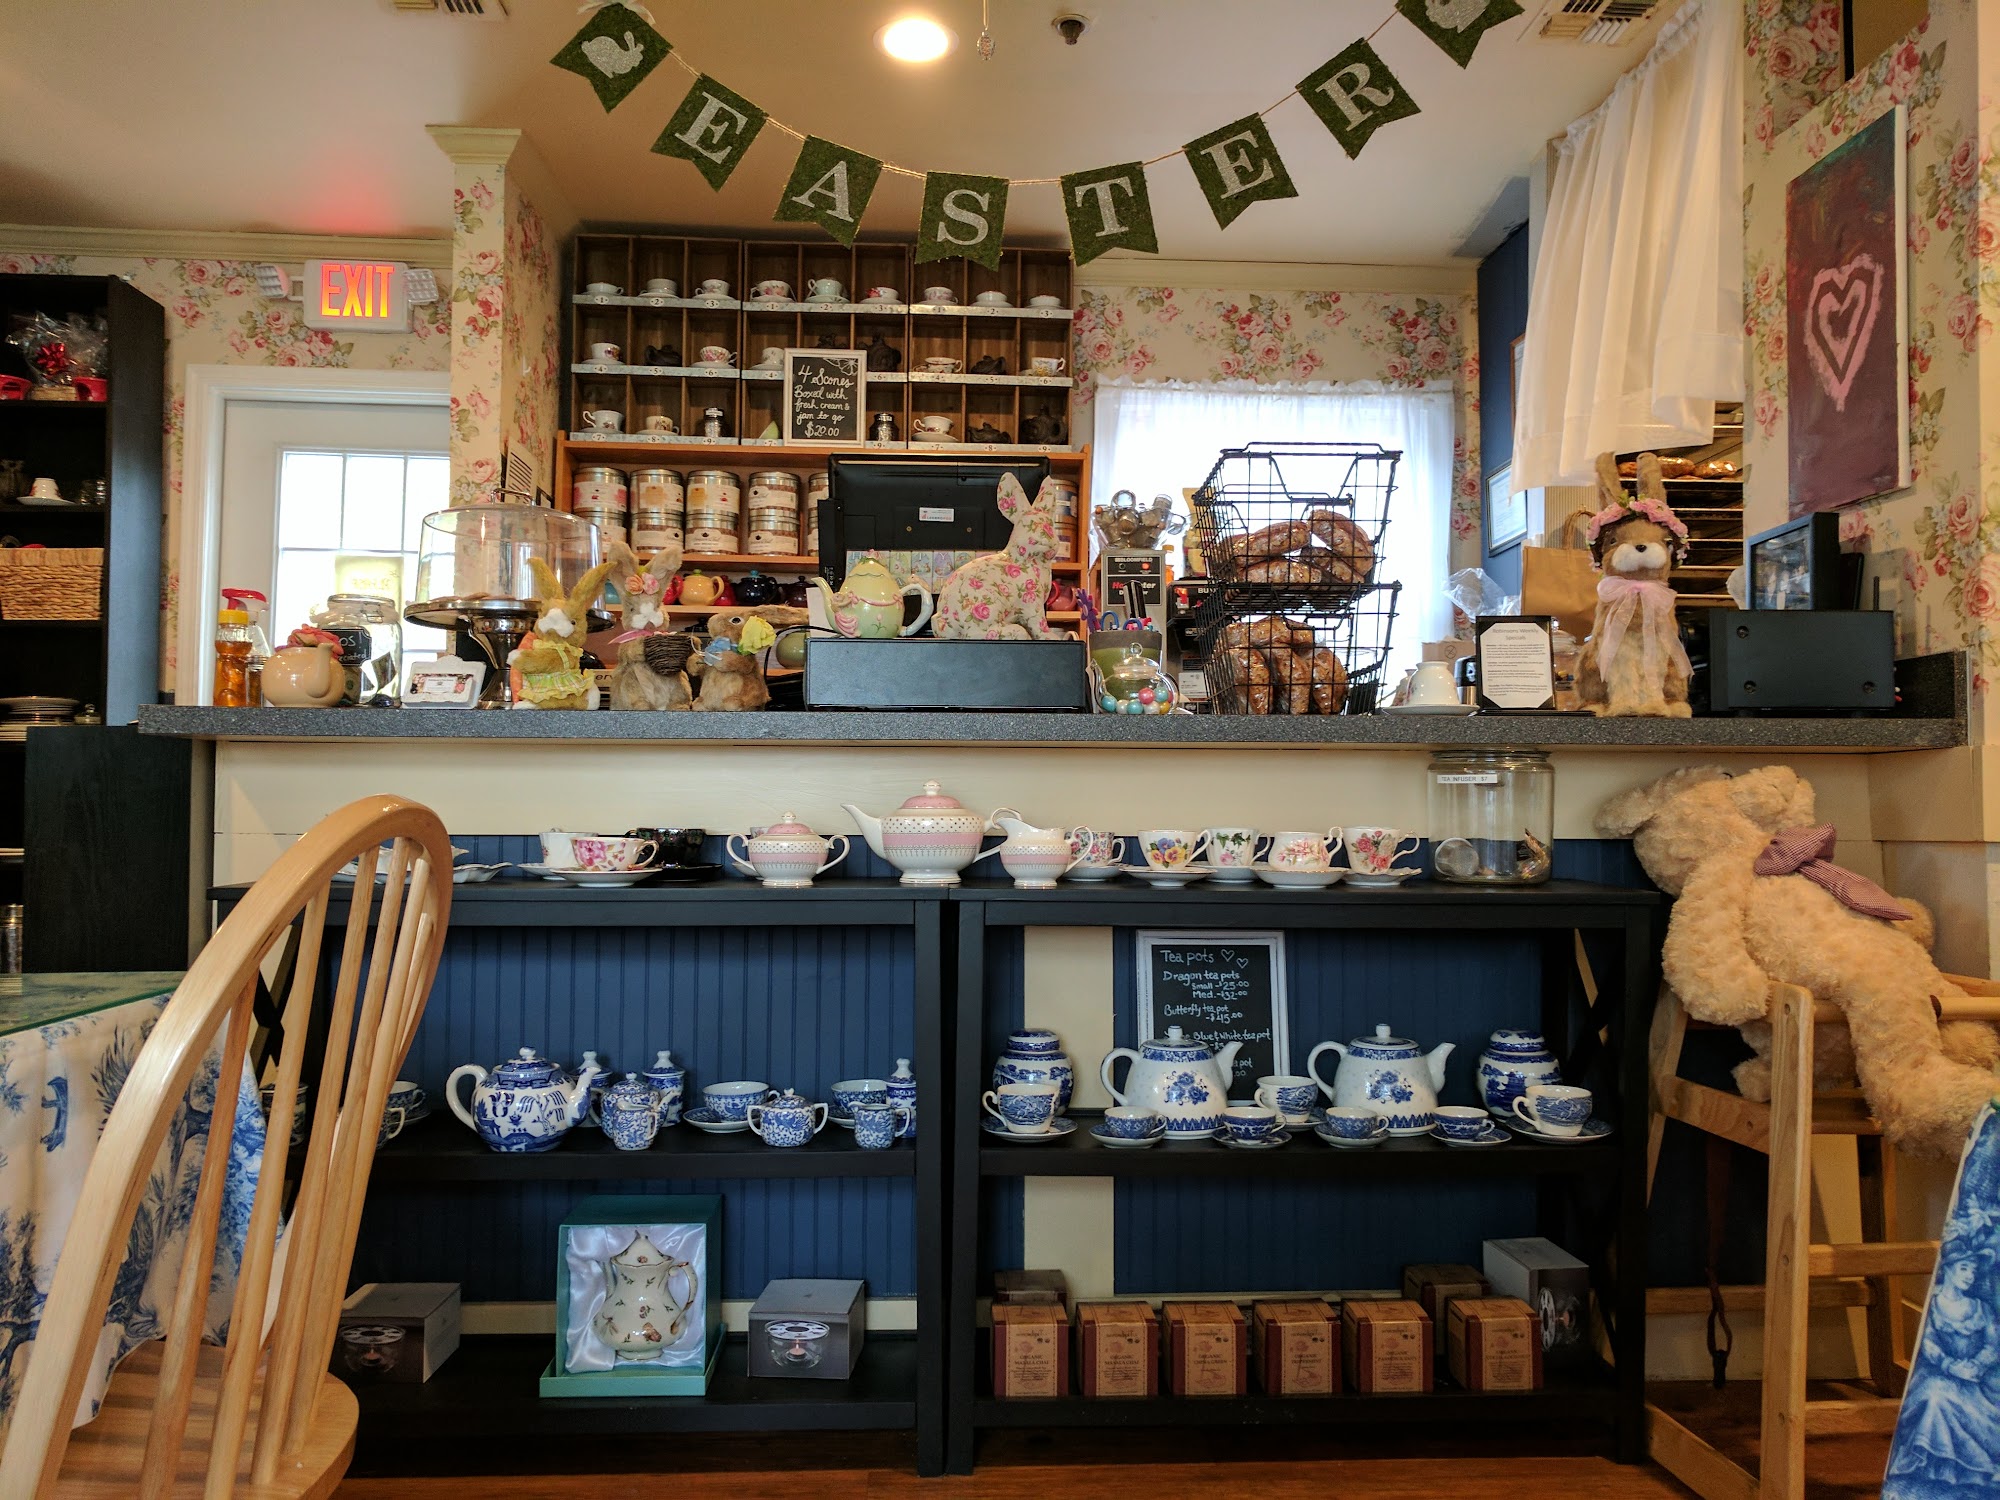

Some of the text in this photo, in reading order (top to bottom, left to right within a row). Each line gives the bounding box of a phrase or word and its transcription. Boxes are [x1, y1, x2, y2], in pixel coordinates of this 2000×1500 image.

[674, 60, 1395, 246] EASTER
[321, 263, 395, 318] EXIT
[798, 365, 854, 388] 4 Scones
[794, 385, 848, 400] Boxed with
[795, 398, 818, 412] fresh
[796, 411, 844, 425] jam to go
[804, 421, 839, 438] $20.00
[1160, 948, 1214, 966] Tea pots
[1163, 970, 1240, 986] Dragon tea pots
[1192, 982, 1212, 990] Small
[1192, 990, 1216, 998] Med.
[1164, 1003, 1229, 1017] Butterfly tea pot
[1256, 1028, 1271, 1042] pot
